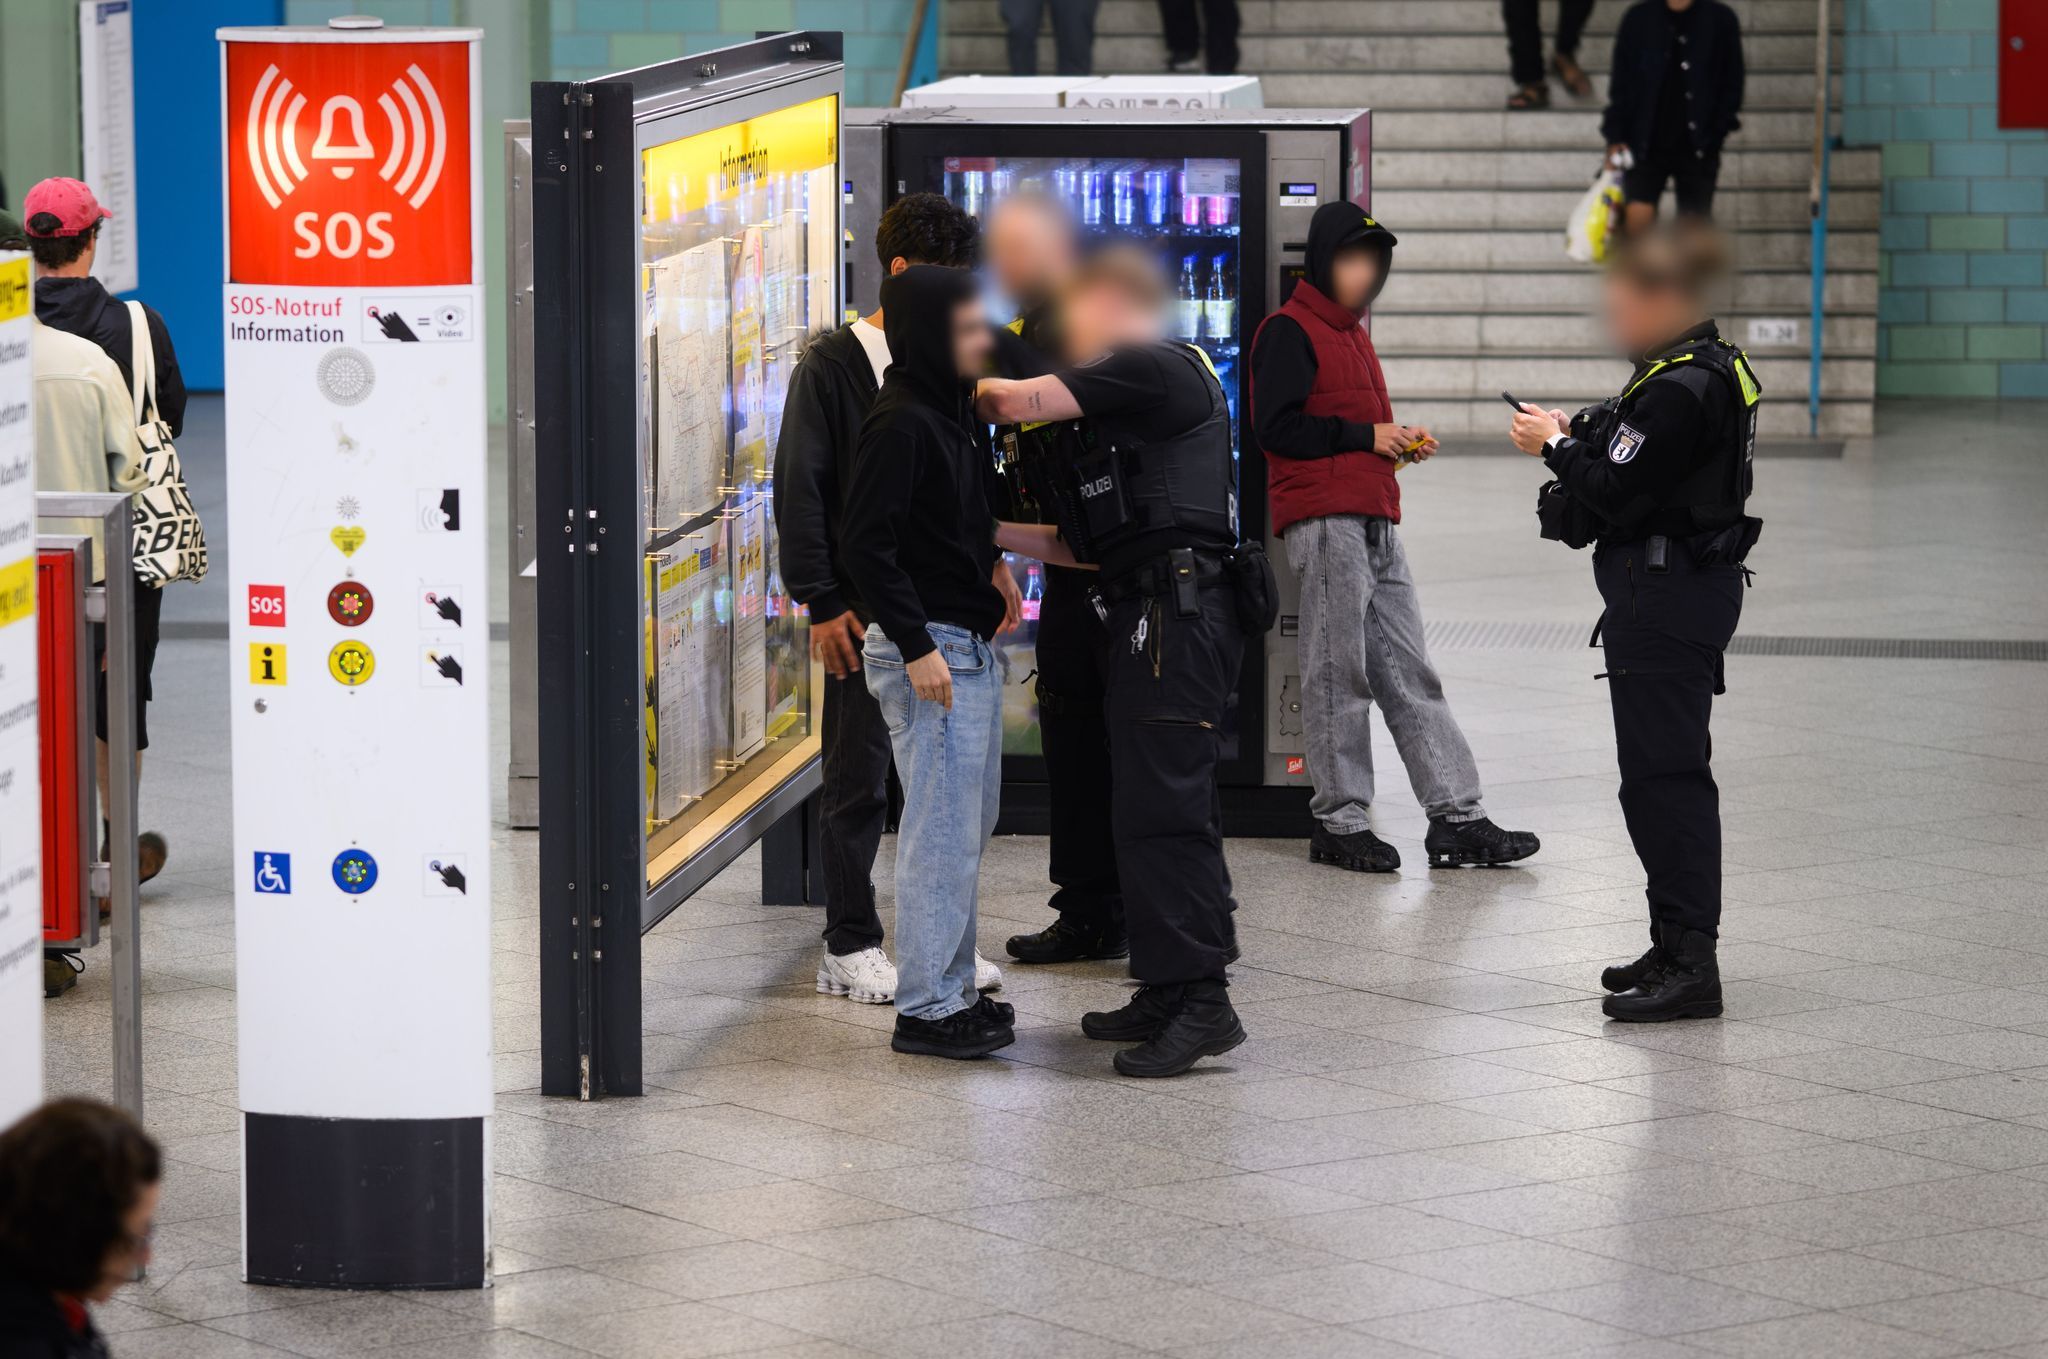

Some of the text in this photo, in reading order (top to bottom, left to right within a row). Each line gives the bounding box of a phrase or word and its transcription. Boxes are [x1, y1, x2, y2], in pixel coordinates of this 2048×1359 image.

[720, 139, 769, 192] Information
[293, 211, 395, 259] SOS
[231, 296, 342, 317] SOS-Notruf
[231, 322, 344, 343] Information
[437, 329, 463, 337] Video
[1620, 425, 1642, 443] POLIZEI
[1080, 475, 1113, 500] POLIZEI
[251, 596, 282, 615] SOS
